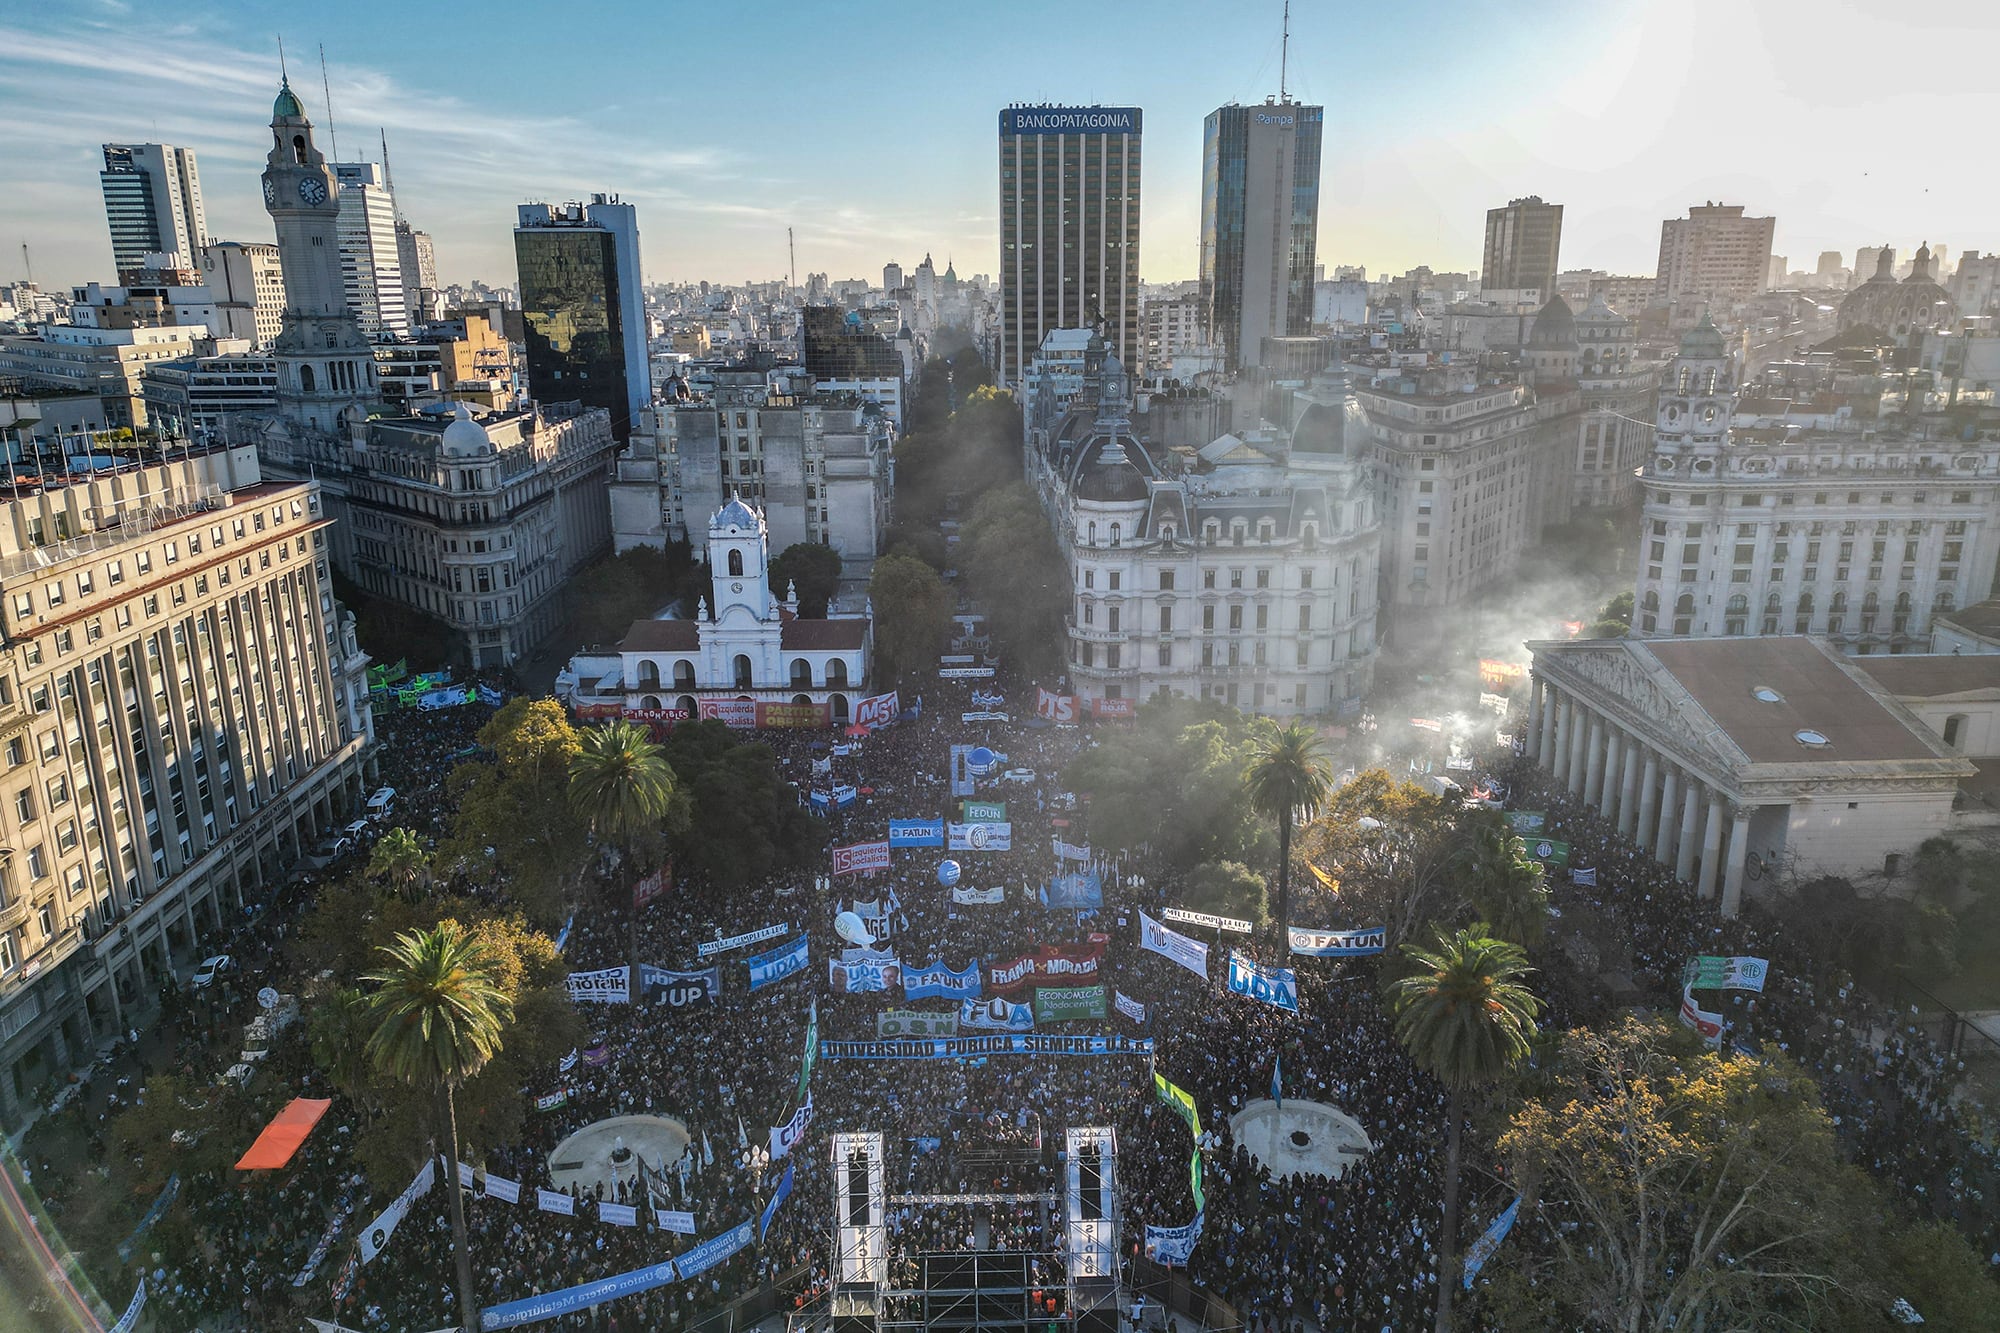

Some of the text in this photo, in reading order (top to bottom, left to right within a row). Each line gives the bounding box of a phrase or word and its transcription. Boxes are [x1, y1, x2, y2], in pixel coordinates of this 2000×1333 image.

[1016, 114, 1130, 128] BANCOPATAGONIA
[1257, 113, 1293, 125] Pampa
[718, 703, 755, 714] izquierda
[764, 704, 825, 716] PARTIDO
[860, 693, 897, 724] MST
[1039, 688, 1073, 721] PTS
[1101, 705, 1128, 713] ROJA
[721, 717, 755, 726] ocialista
[765, 717, 822, 728] OBRERO
[969, 806, 1001, 819] FEDUN
[902, 828, 931, 837] FATUN
[852, 845, 888, 858] izquierda
[851, 854, 888, 866] socialista
[1315, 934, 1383, 948] FATUN
[762, 954, 801, 981] UDA
[848, 963, 882, 980] UDA
[991, 958, 1036, 985] FRANJA
[1046, 957, 1099, 975] MORADA
[920, 973, 963, 990] FATUN
[1229, 962, 1298, 1012] UDA
[655, 987, 703, 1007] JUP
[1038, 989, 1105, 1000] ECONOMICAS
[1044, 1000, 1100, 1010] Nodocentes
[884, 1011, 954, 1020] SINDICATO
[968, 1001, 1033, 1027] FUA
[826, 1042, 935, 1057] UNIVERSIDAD
[1024, 1035, 1094, 1052] SIEMPRE
[538, 1091, 564, 1109] EPA
